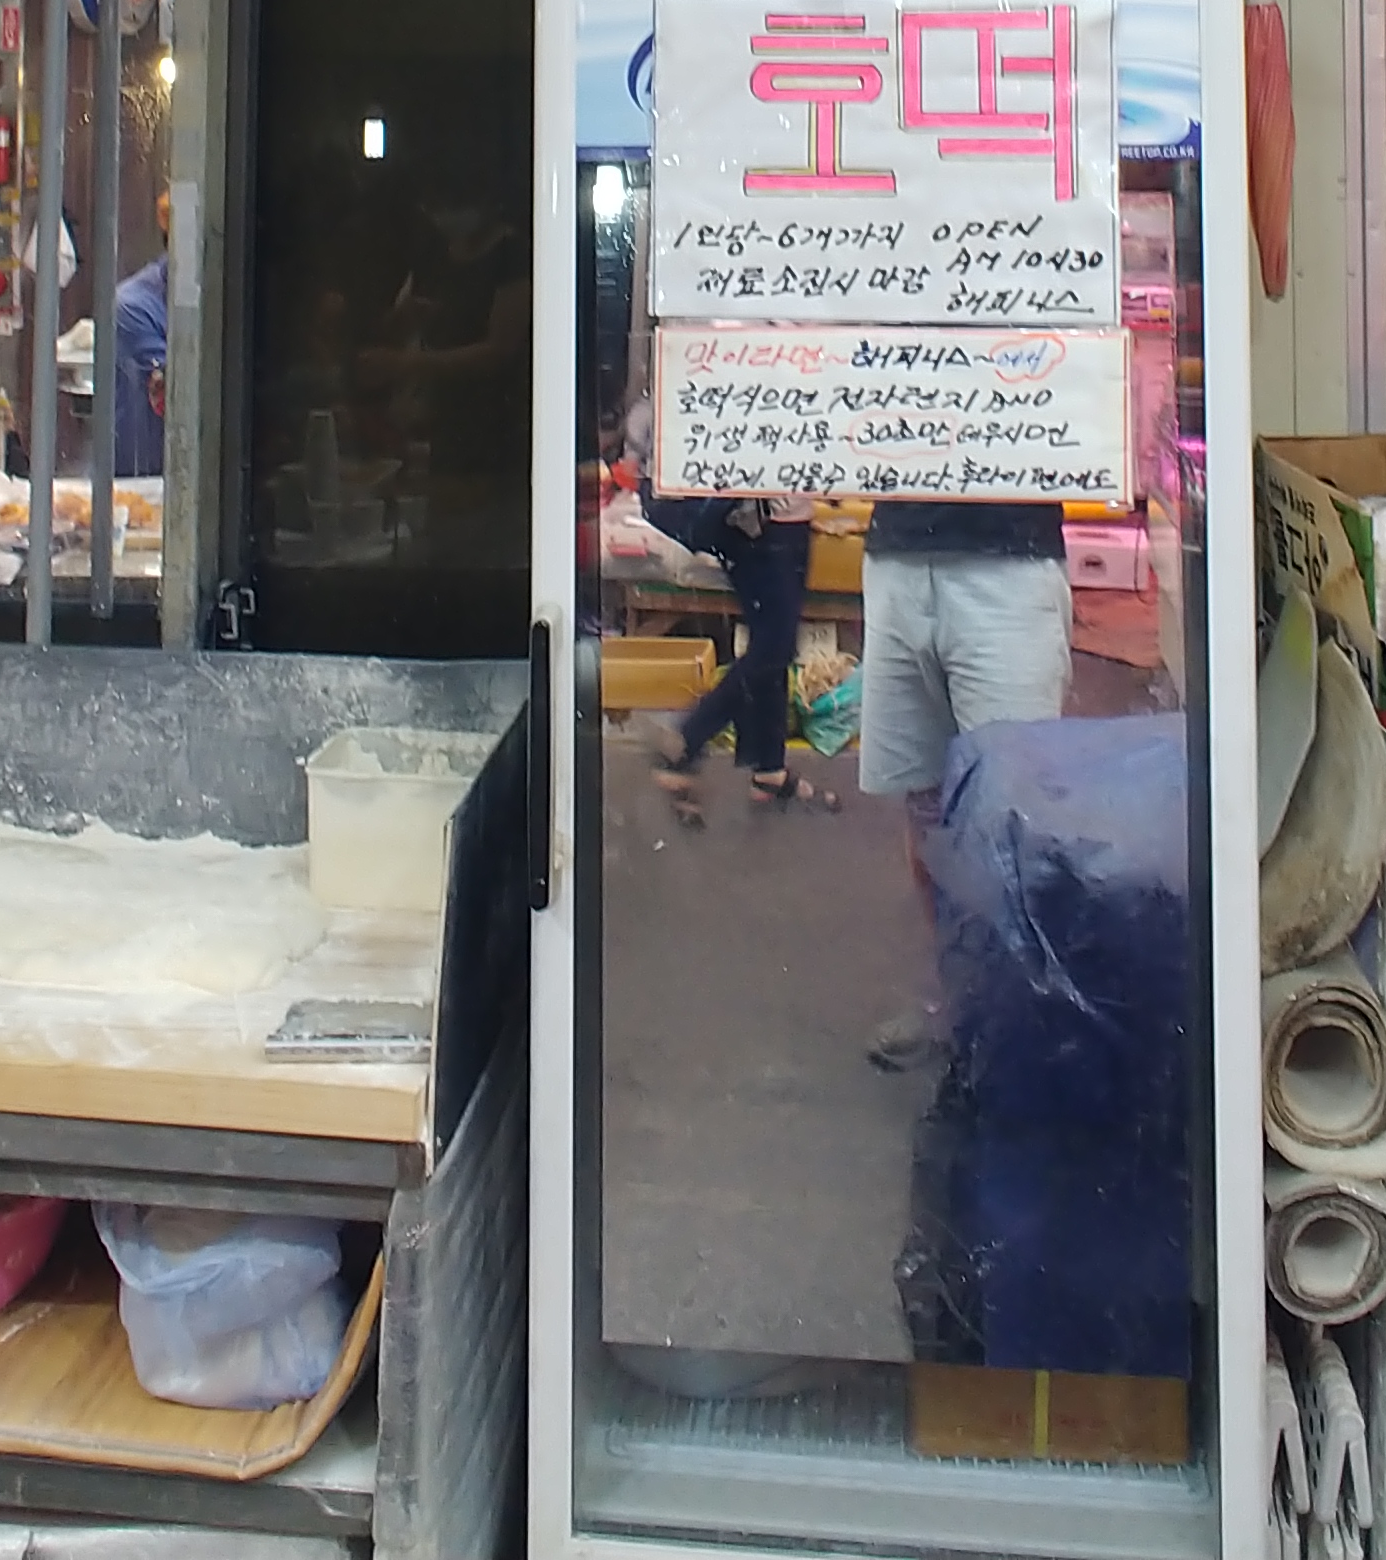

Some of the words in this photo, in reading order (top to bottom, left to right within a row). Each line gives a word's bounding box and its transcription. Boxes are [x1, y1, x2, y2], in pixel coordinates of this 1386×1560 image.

[743, 5, 1078, 202] 호떡
[932, 214, 1044, 243] OPEN
[946, 247, 1002, 275] AM
[946, 281, 1095, 316] 해피니스
